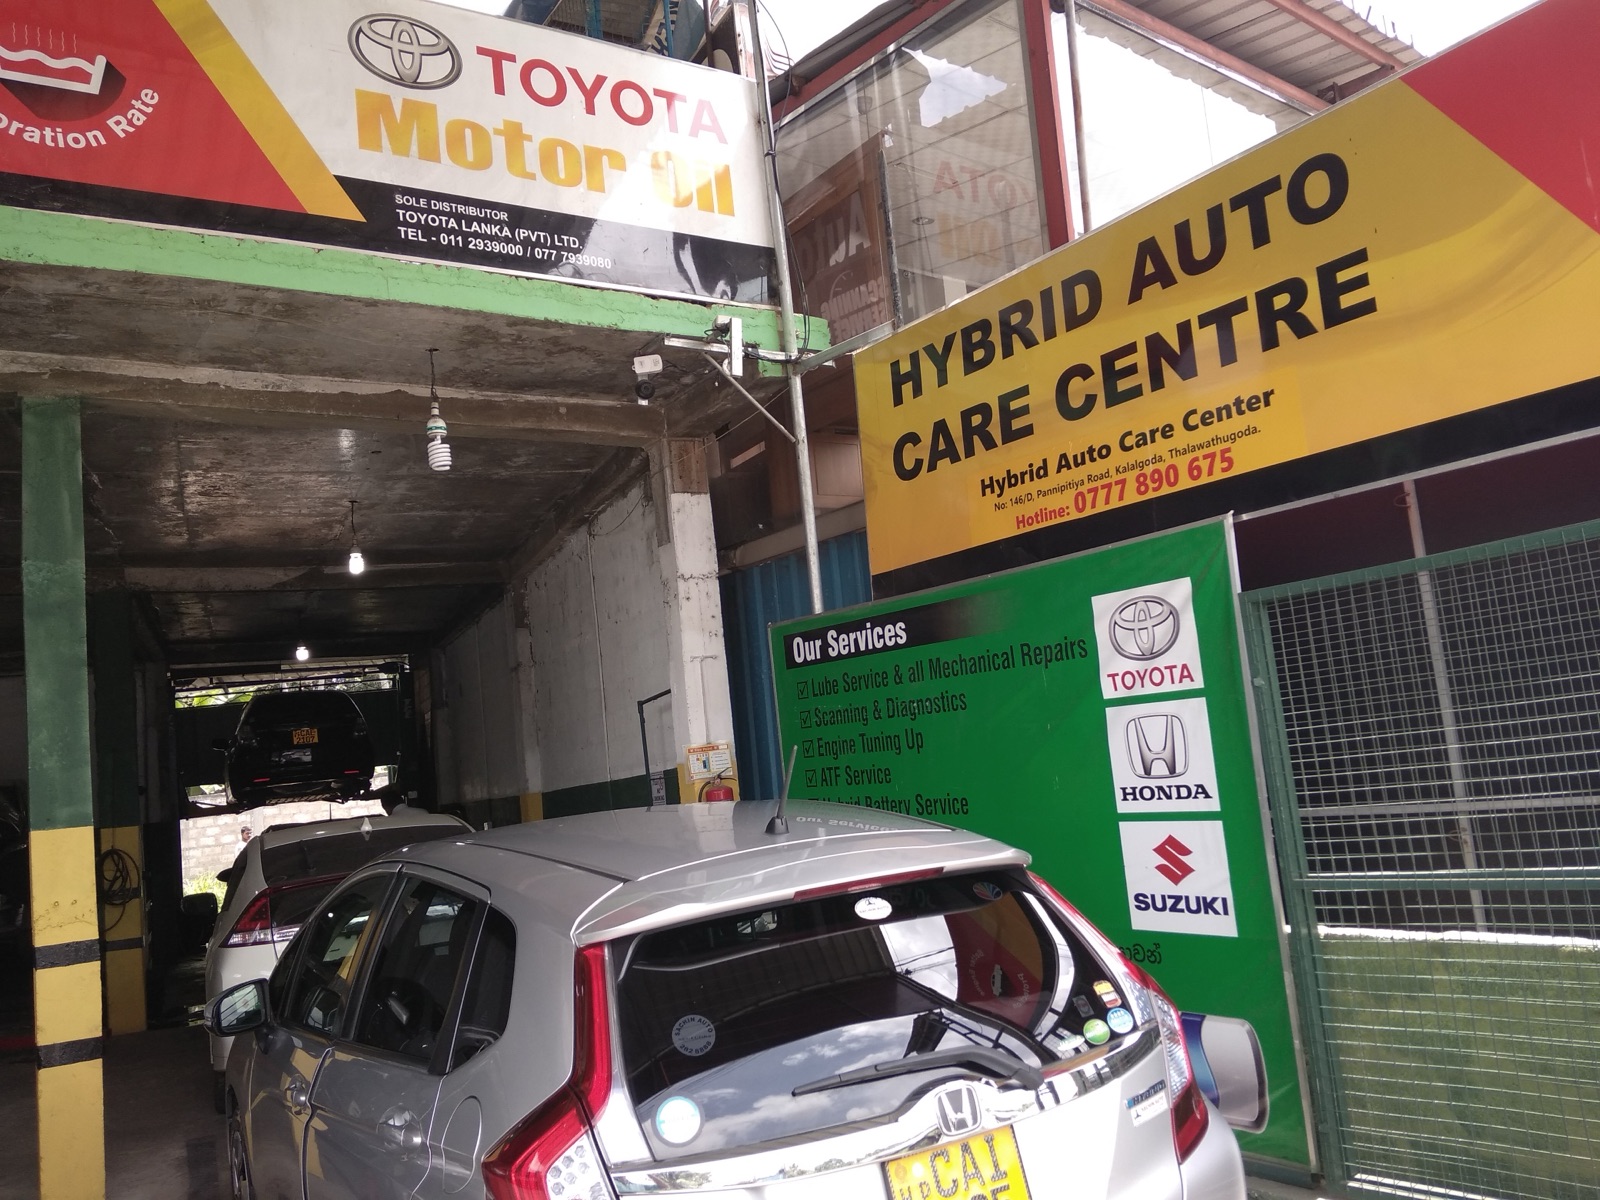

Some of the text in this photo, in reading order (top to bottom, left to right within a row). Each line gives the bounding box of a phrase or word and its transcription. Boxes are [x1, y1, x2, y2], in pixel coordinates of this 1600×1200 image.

[106, 88, 159, 138] Rate
[476, 46, 728, 144] TOYOTA
[355, 88, 626, 193] Motor
[395, 194, 509, 222] SOLE DISTRIBUTOR
[396, 209, 583, 250] TOYOTA LANKA (PVT) LTD.
[397, 226, 428, 243] TEL
[440, 233, 463, 248] 011
[468, 237, 524, 256] 2939000
[527, 246, 531, 257] /
[534, 248, 557, 261] 077
[561, 251, 612, 269] 7939080
[890, 153, 1349, 407] HYBRID AUTO
[893, 247, 1378, 482] CARE CENTRE
[980, 389, 1275, 498] Hybrid Auto Care Center
[994, 424, 1262, 512] No: 146/D, Pannipitiya Road, Kalalgoda, Thalawathugoda.
[1015, 446, 1234, 530] Hotline: 0777 890 675
[793, 620, 908, 664] Our Services
[811, 635, 1088, 698] Lube Service & all Mechanical Repairs
[1107, 663, 1194, 692] TOYOTA
[814, 690, 967, 727] Scanning & Diagnostics
[817, 728, 924, 760] Engine Tuning Up
[820, 764, 892, 788] ATF Service
[1120, 784, 1213, 802] HONDA
[915, 792, 969, 816] Service
[1134, 892, 1230, 917] SUZUKI
[675, 1016, 713, 1036] SACHIN AUTO
